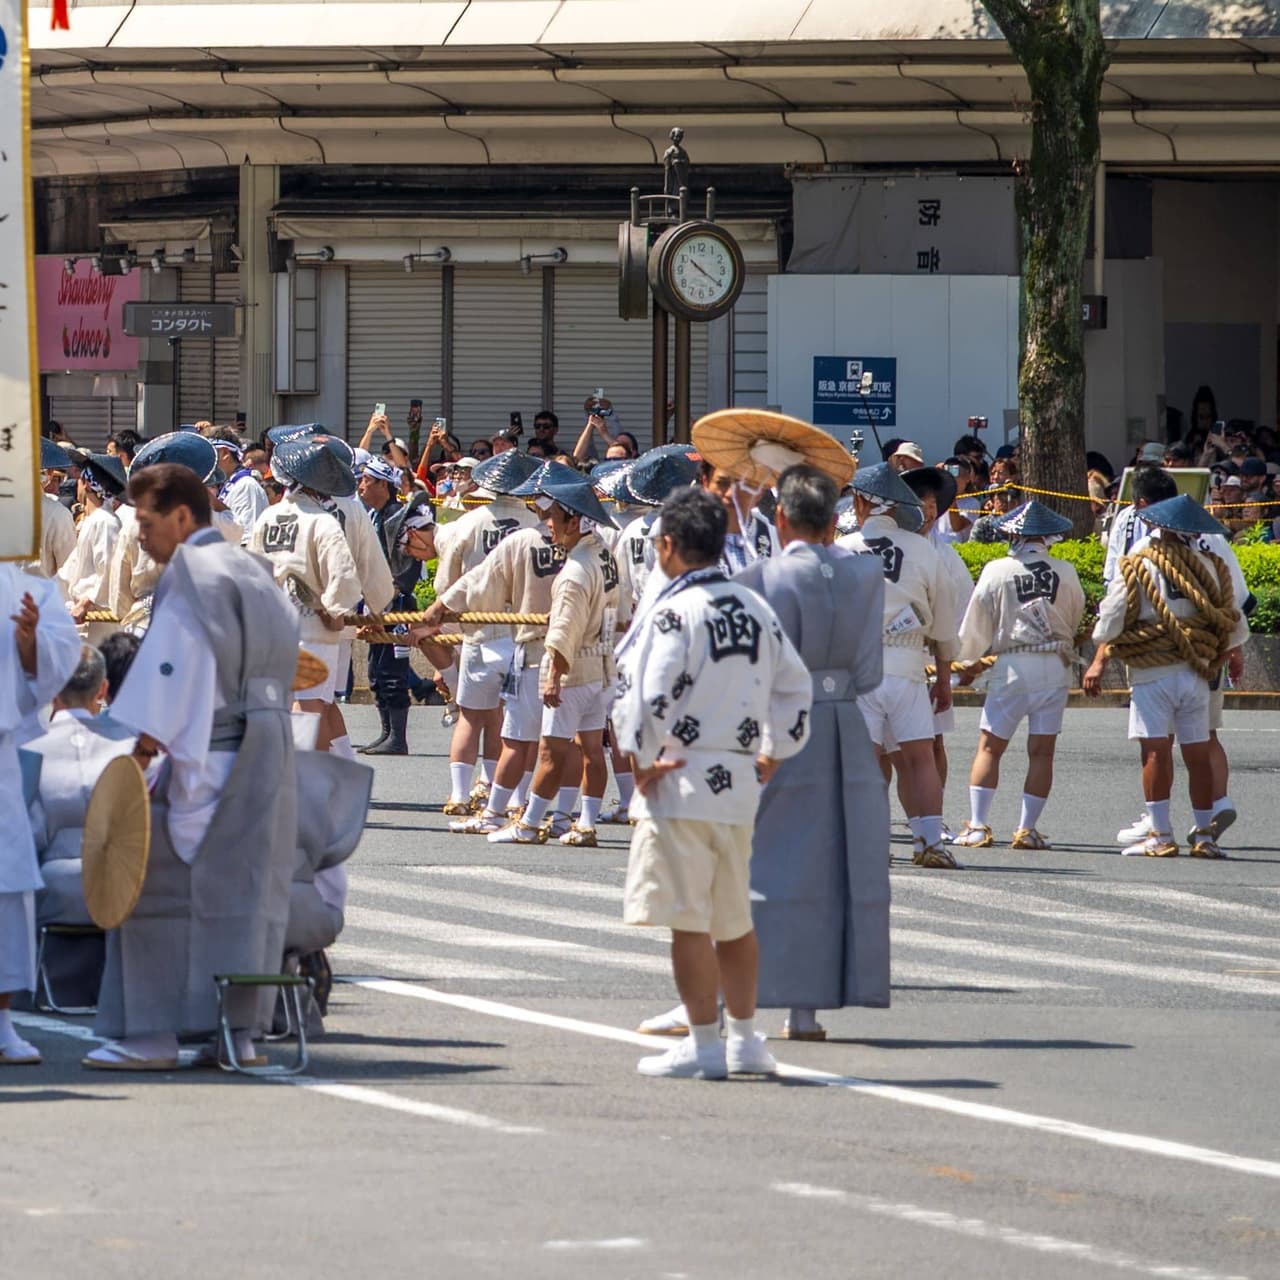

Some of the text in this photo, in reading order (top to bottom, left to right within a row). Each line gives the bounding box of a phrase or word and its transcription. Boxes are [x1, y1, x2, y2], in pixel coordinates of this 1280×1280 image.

[151, 319, 213, 332] コンタクト
[818, 380, 892, 392] 阪急 京都町駅
